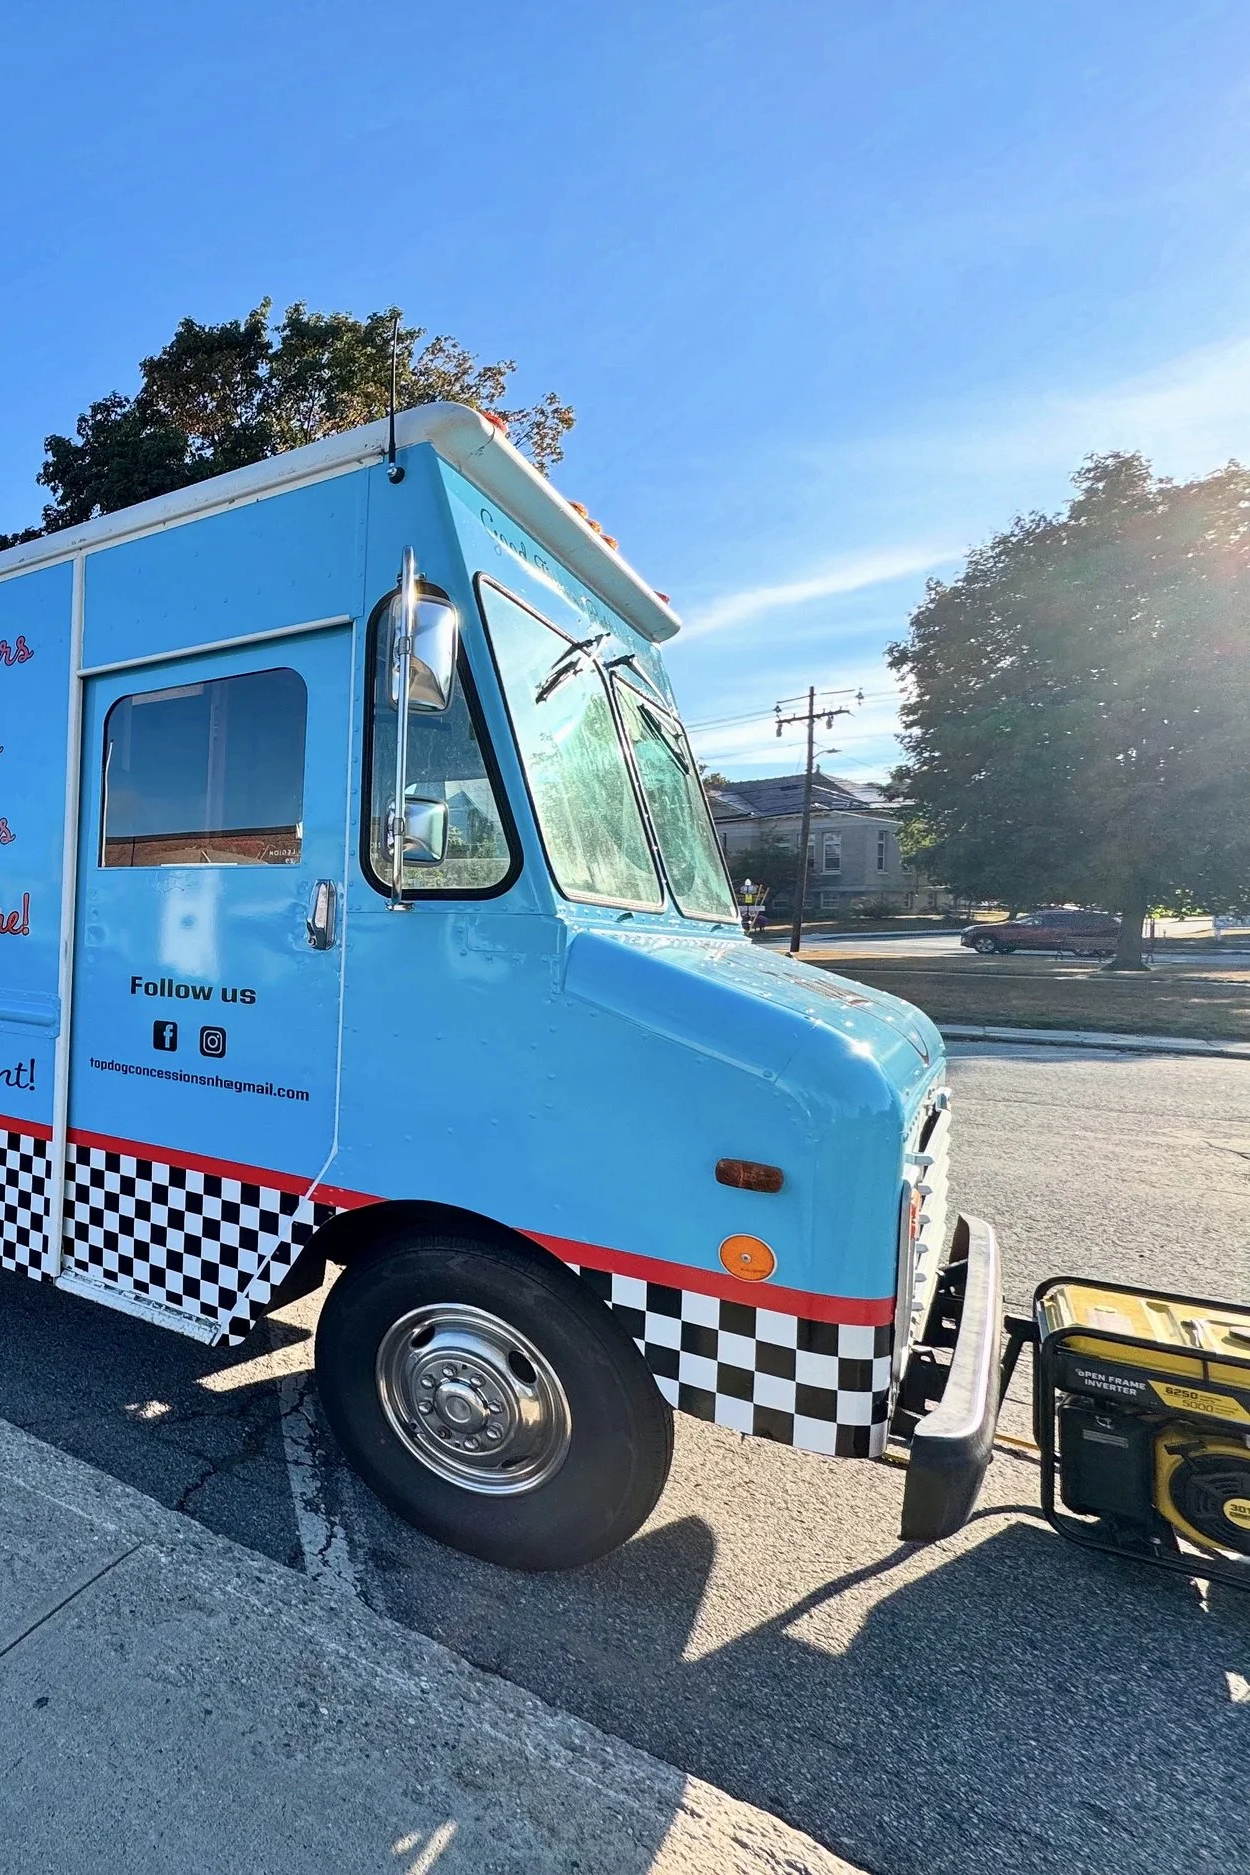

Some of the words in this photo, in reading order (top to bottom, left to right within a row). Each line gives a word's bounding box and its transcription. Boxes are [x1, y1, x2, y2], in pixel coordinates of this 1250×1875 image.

[130, 976, 213, 1001] Follow
[221, 987, 257, 1005] us
[89, 1057, 310, 1101] topdogconcessionsnh@gmail.com
[1076, 1369, 1105, 1381] OPEN
[1108, 1376, 1146, 1390] FRAME
[1085, 1379, 1137, 1396] INVERTER
[1165, 1387, 1198, 1399] 6250
[1182, 1400, 1214, 1412] 5000
